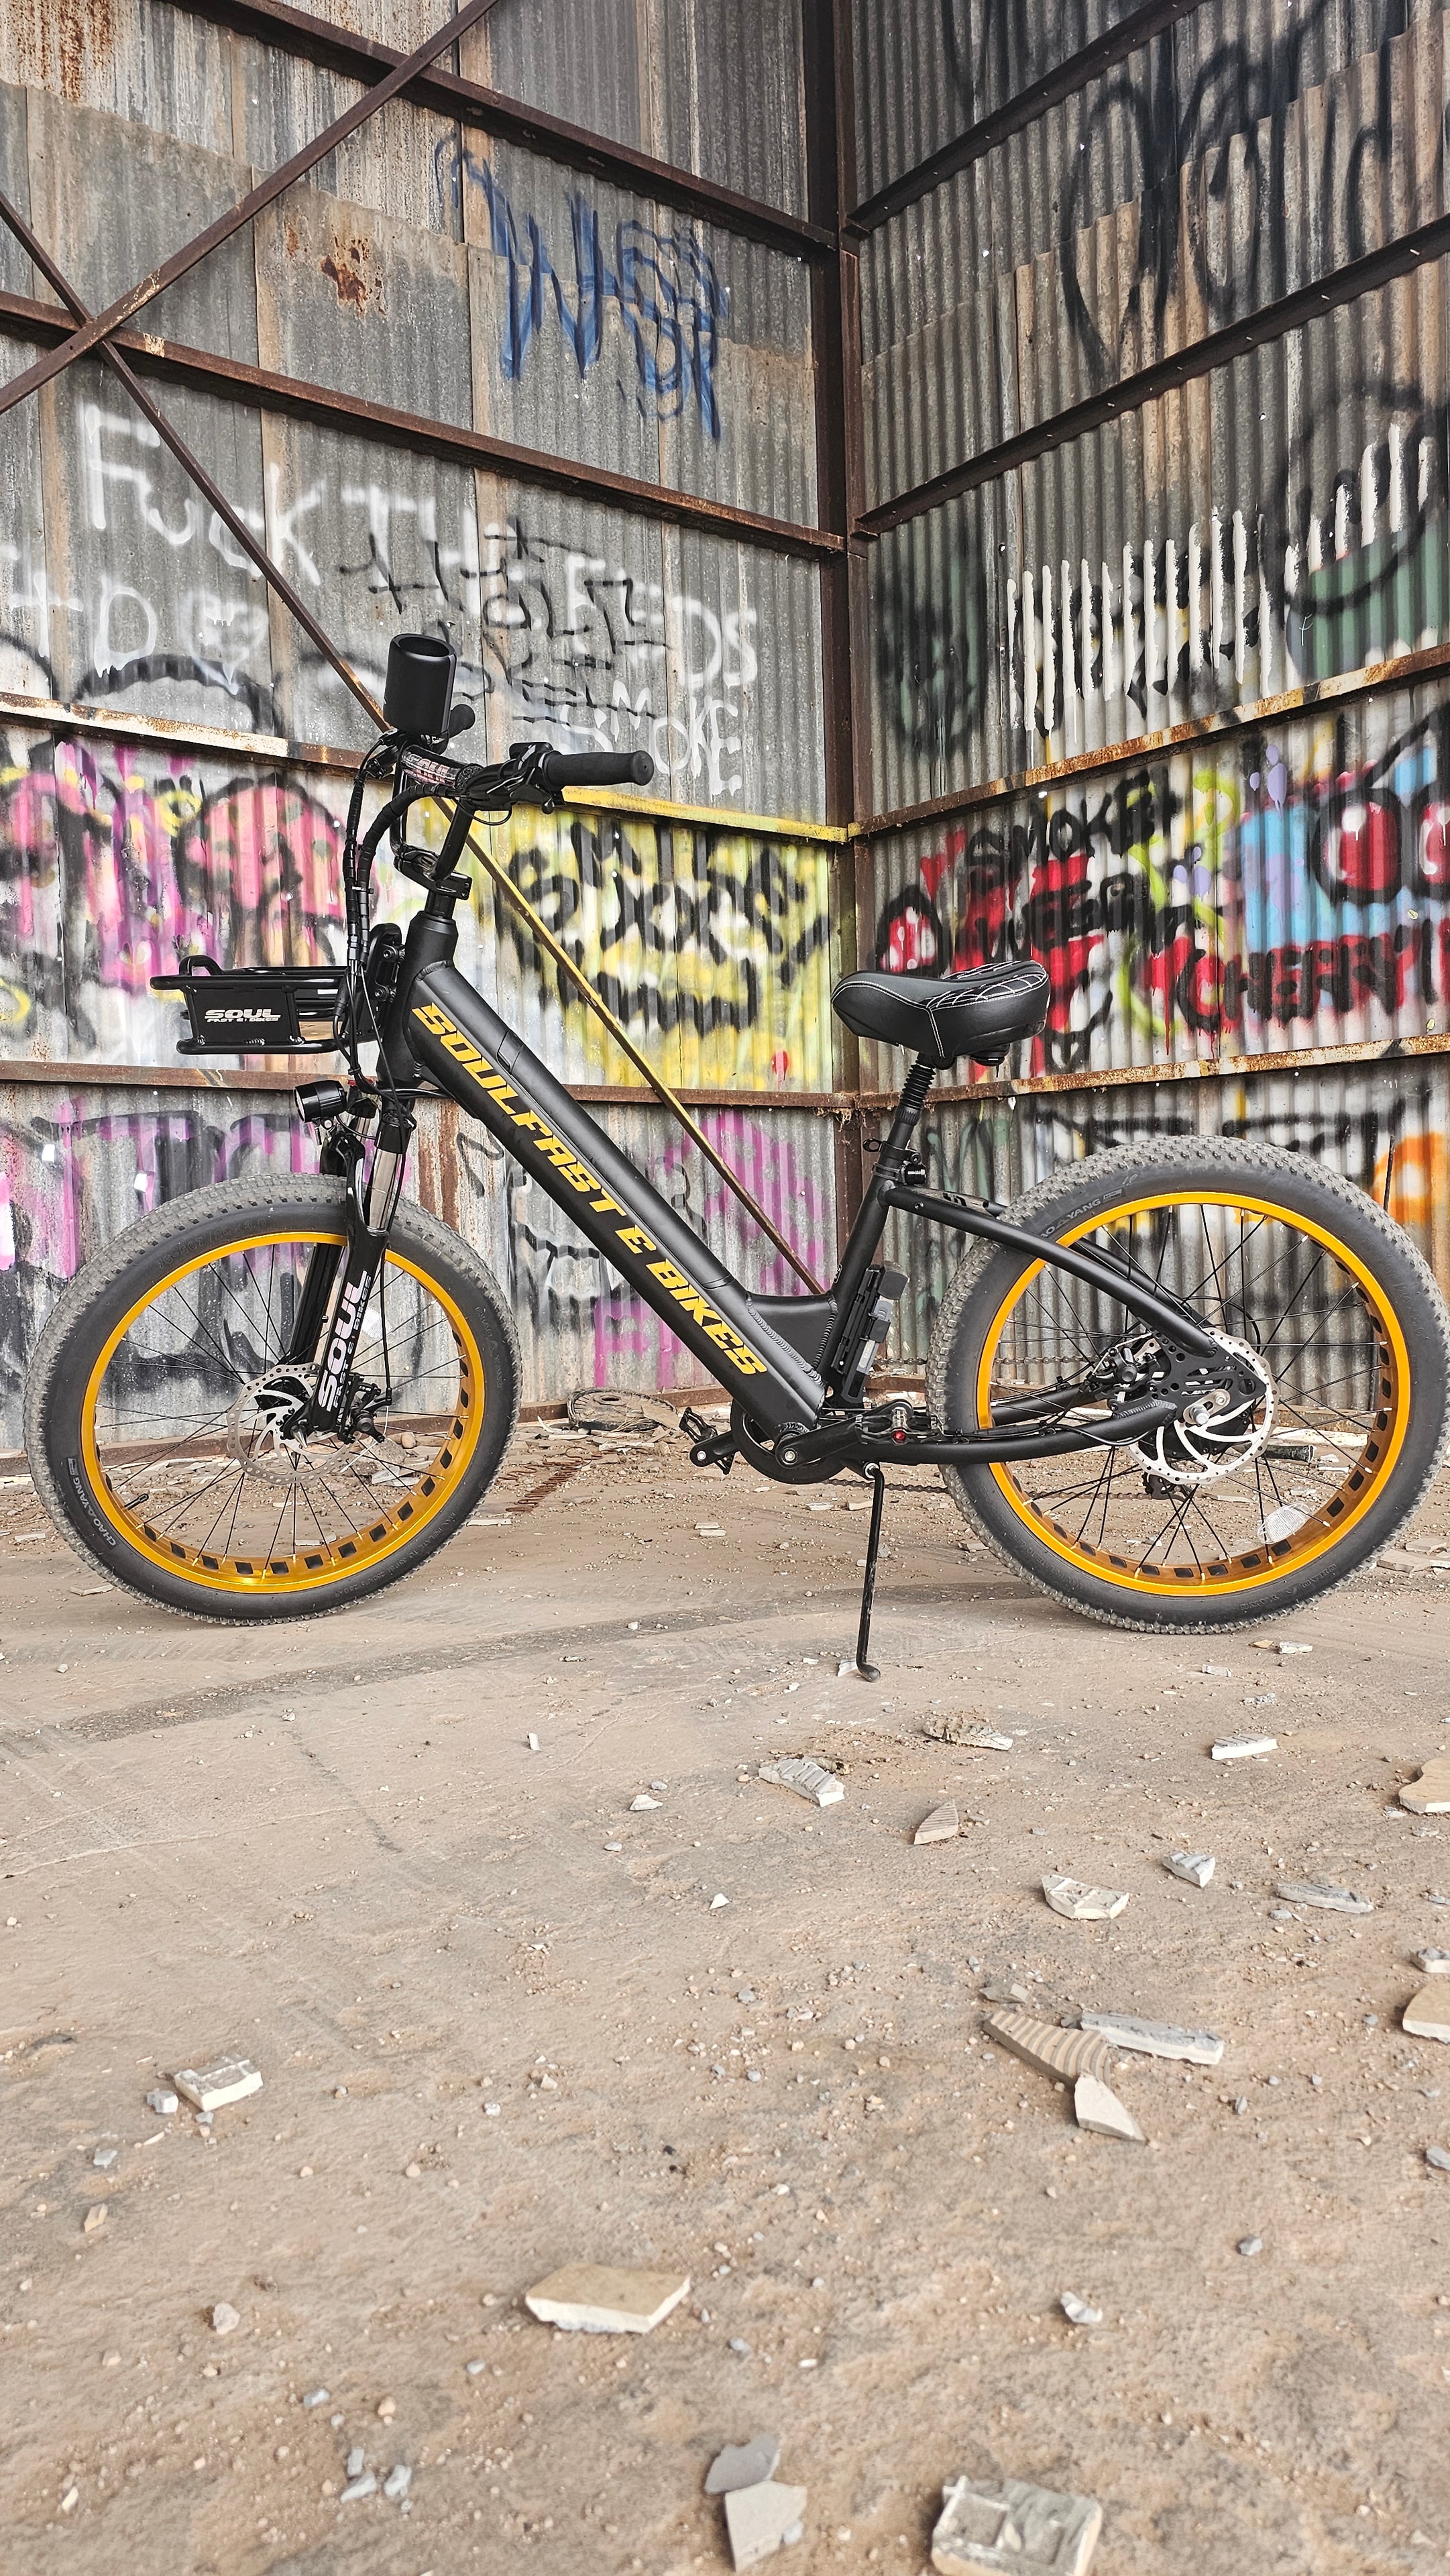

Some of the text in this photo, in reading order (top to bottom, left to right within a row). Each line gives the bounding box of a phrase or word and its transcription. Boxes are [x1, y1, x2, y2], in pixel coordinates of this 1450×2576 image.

[559, 679, 742, 798] SMOKE
[204, 1008, 282, 1019] SOUL
[1066, 1198, 1101, 1220] YANG
[353, 1275, 372, 1330] BIKES
[615, 1224, 657, 1254] E
[646, 1258, 767, 1375] BIKES
[318, 1270, 368, 1412] SOUL
[72, 1477, 89, 1509] YANG
[93, 1517, 117, 1546] CHAO
